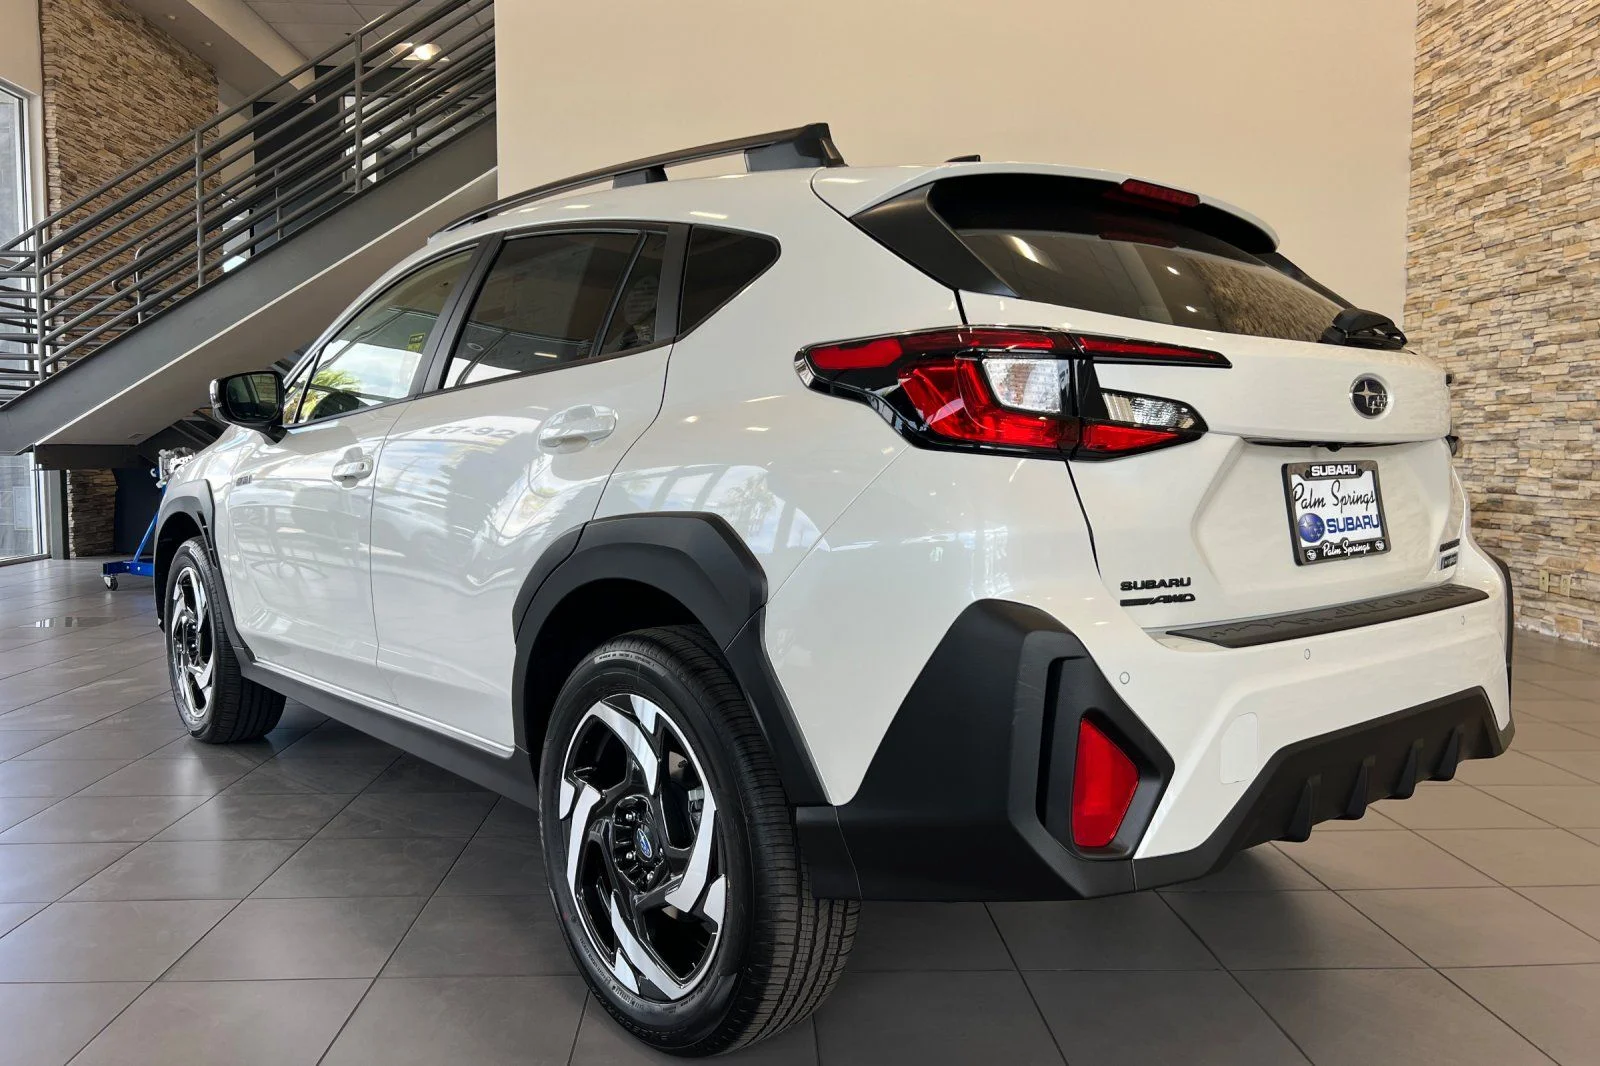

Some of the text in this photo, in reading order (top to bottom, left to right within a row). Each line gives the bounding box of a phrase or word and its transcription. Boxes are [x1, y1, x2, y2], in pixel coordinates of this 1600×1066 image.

[1311, 464, 1357, 477] SUBARU
[1293, 479, 1376, 513] Palm Springs
[1326, 514, 1380, 534] SUBARU
[1322, 540, 1371, 557] Palm Springs
[1120, 577, 1191, 591] SUBARU
[1148, 593, 1196, 605] AWD
